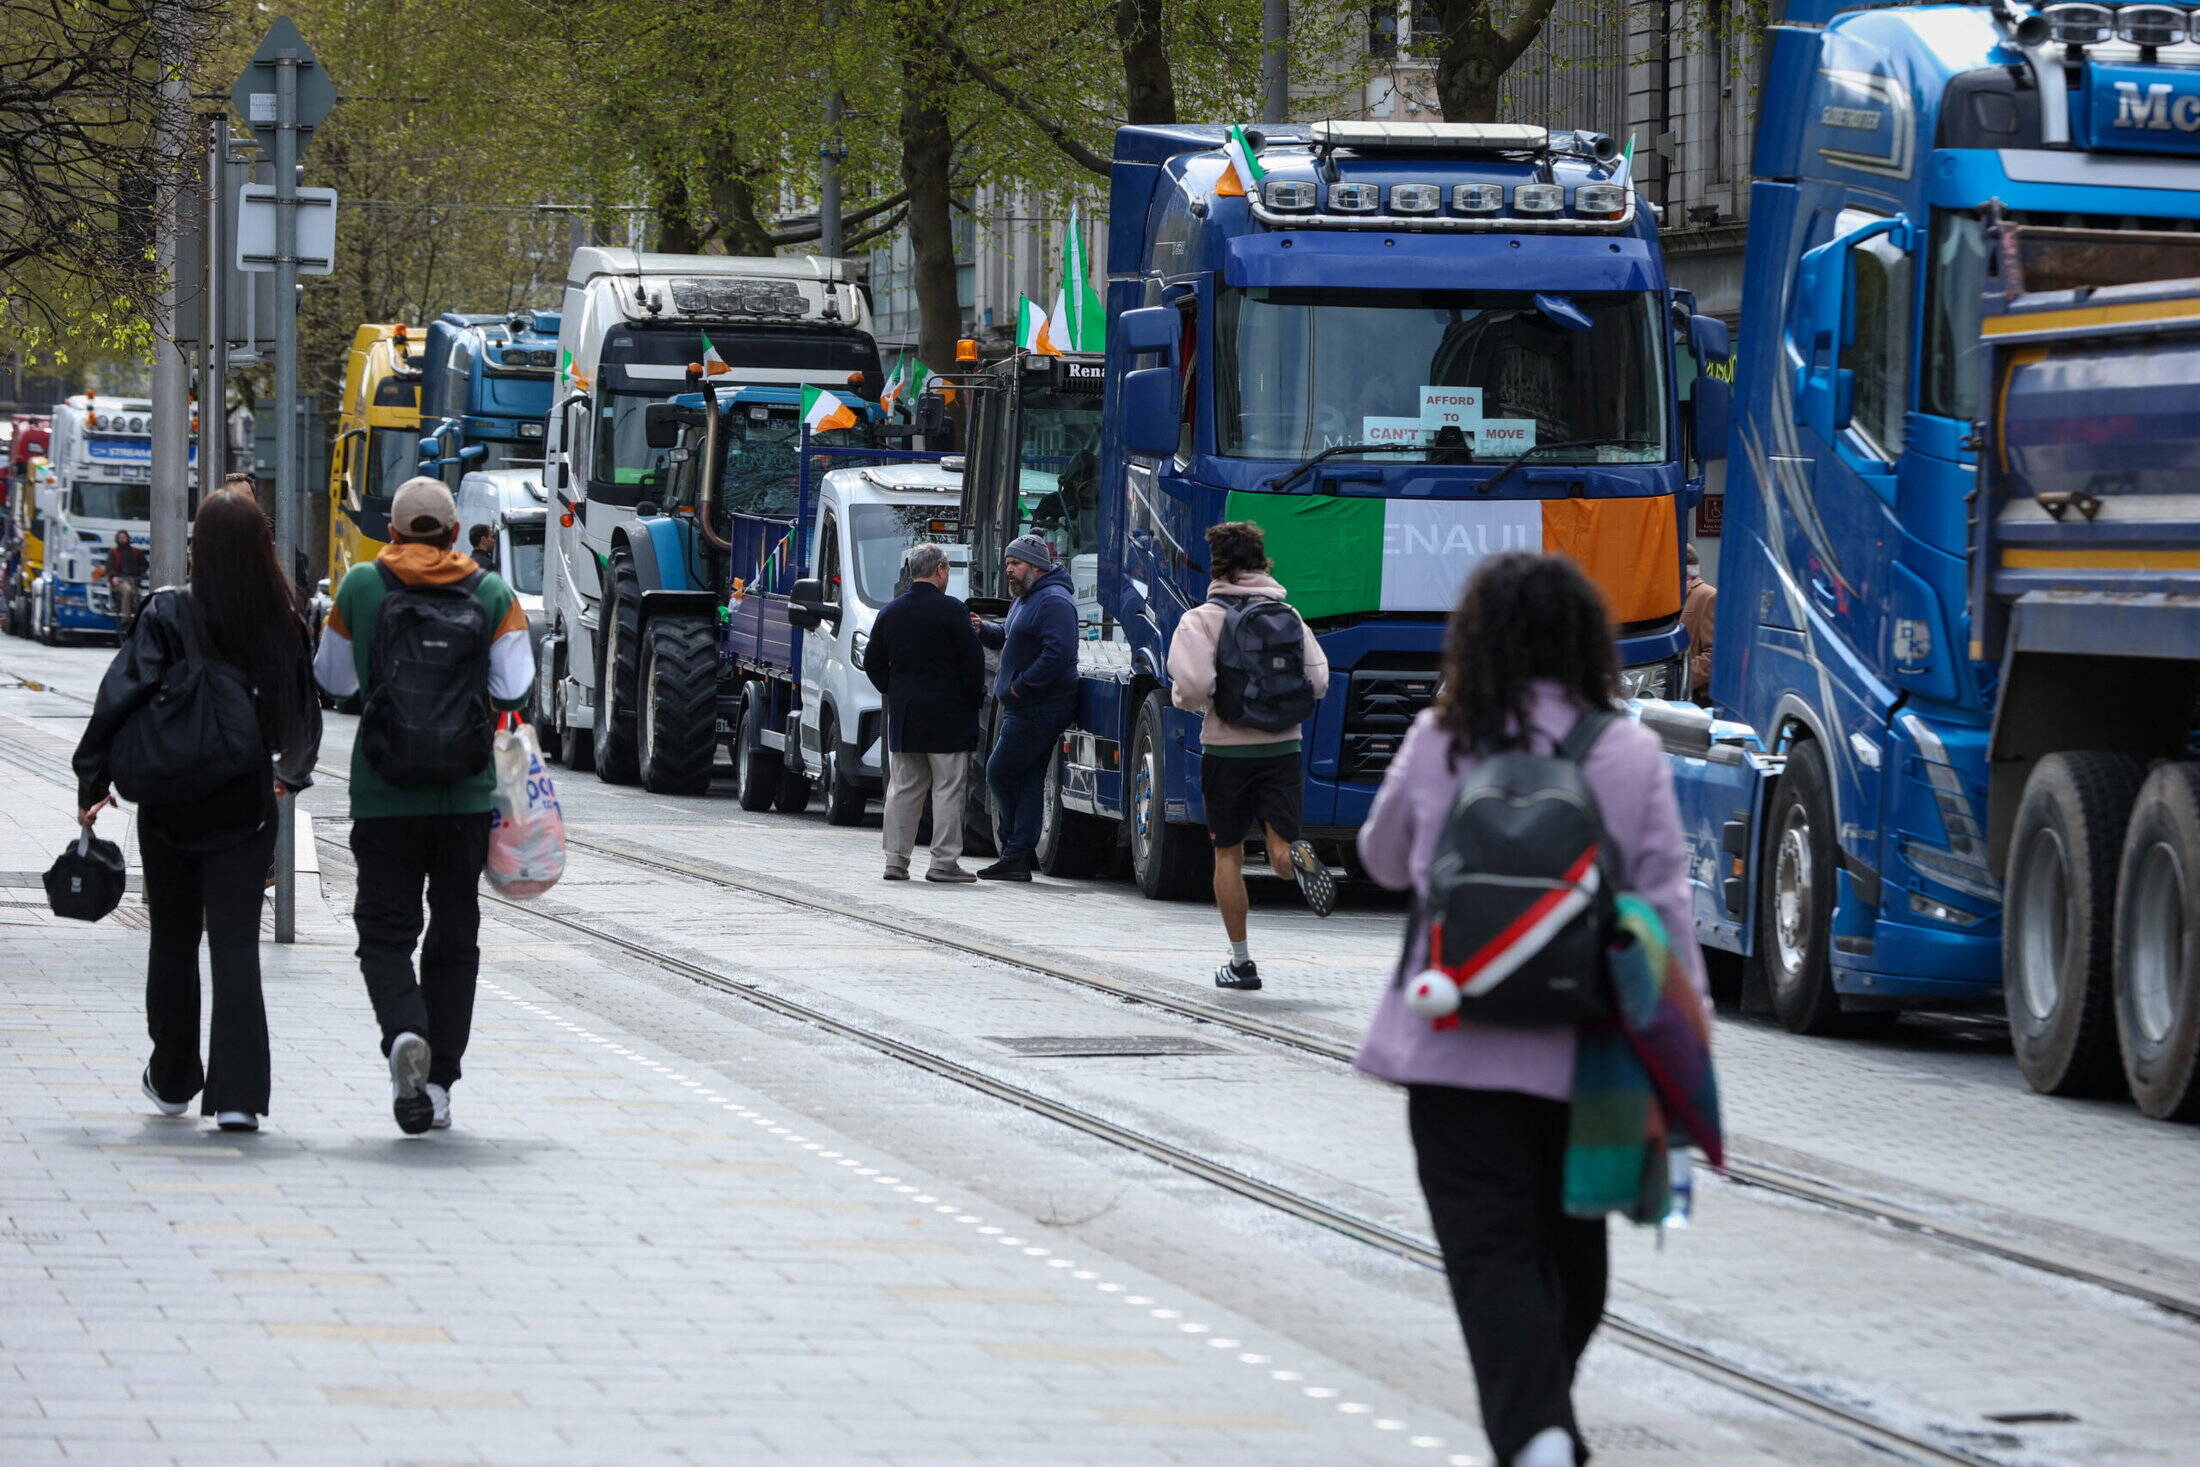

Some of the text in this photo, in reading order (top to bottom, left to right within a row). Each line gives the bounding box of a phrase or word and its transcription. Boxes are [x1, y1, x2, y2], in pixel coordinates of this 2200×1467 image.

[1426, 395, 1475, 406] AFFORD
[1443, 413, 1460, 422] TO
[1370, 427, 1419, 441] CAN'T
[1485, 429, 1525, 439] MOVE
